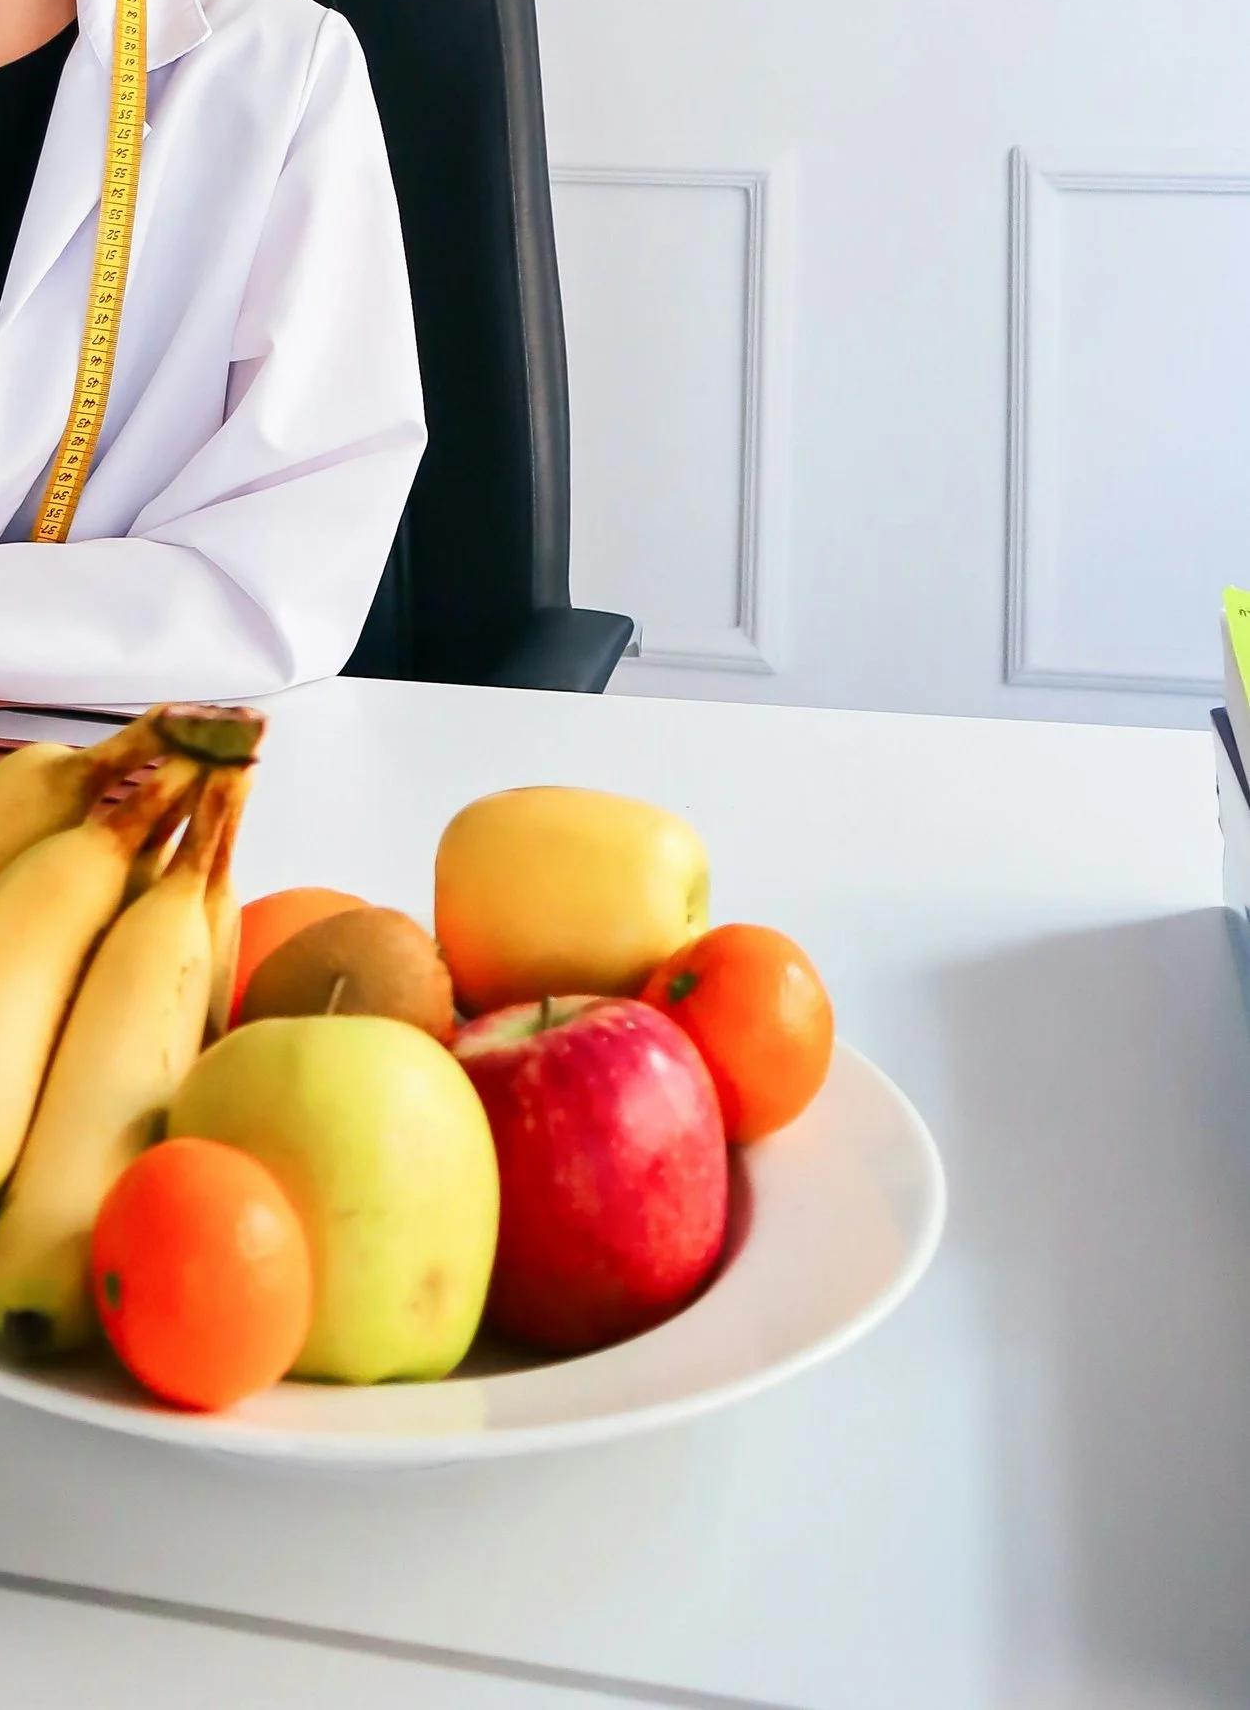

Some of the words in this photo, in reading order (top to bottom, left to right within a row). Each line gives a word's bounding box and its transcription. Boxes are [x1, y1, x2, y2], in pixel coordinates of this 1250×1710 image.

[125, 26, 137, 35] 63
[124, 42, 136, 50] 62
[125, 58, 135, 66] 61
[122, 74, 134, 83] 60
[121, 91, 135, 101] 59
[118, 109, 133, 119] 58
[117, 129, 131, 139] 57
[116, 148, 129, 159] 56
[114, 168, 128, 178] 55
[111, 188, 125, 198] 54
[108, 209, 123, 220] 53
[106, 230, 121, 240] 52
[106, 250, 117, 260] 51
[103, 271, 117, 282] 50
[99, 293, 112, 303] 49
[95, 313, 109, 324] 48
[92, 335, 105, 345] 47
[90, 355, 102, 366] 46
[86, 377, 99, 388] 45
[82, 398, 96, 408] 44
[76, 418, 91, 428] 43
[71, 436, 85, 446] 42
[67, 455, 79, 464] 41
[58, 472, 72, 482] 40
[53, 491, 69, 500] 39
[46, 509, 63, 518] 38
[40, 524, 57, 535] 37
